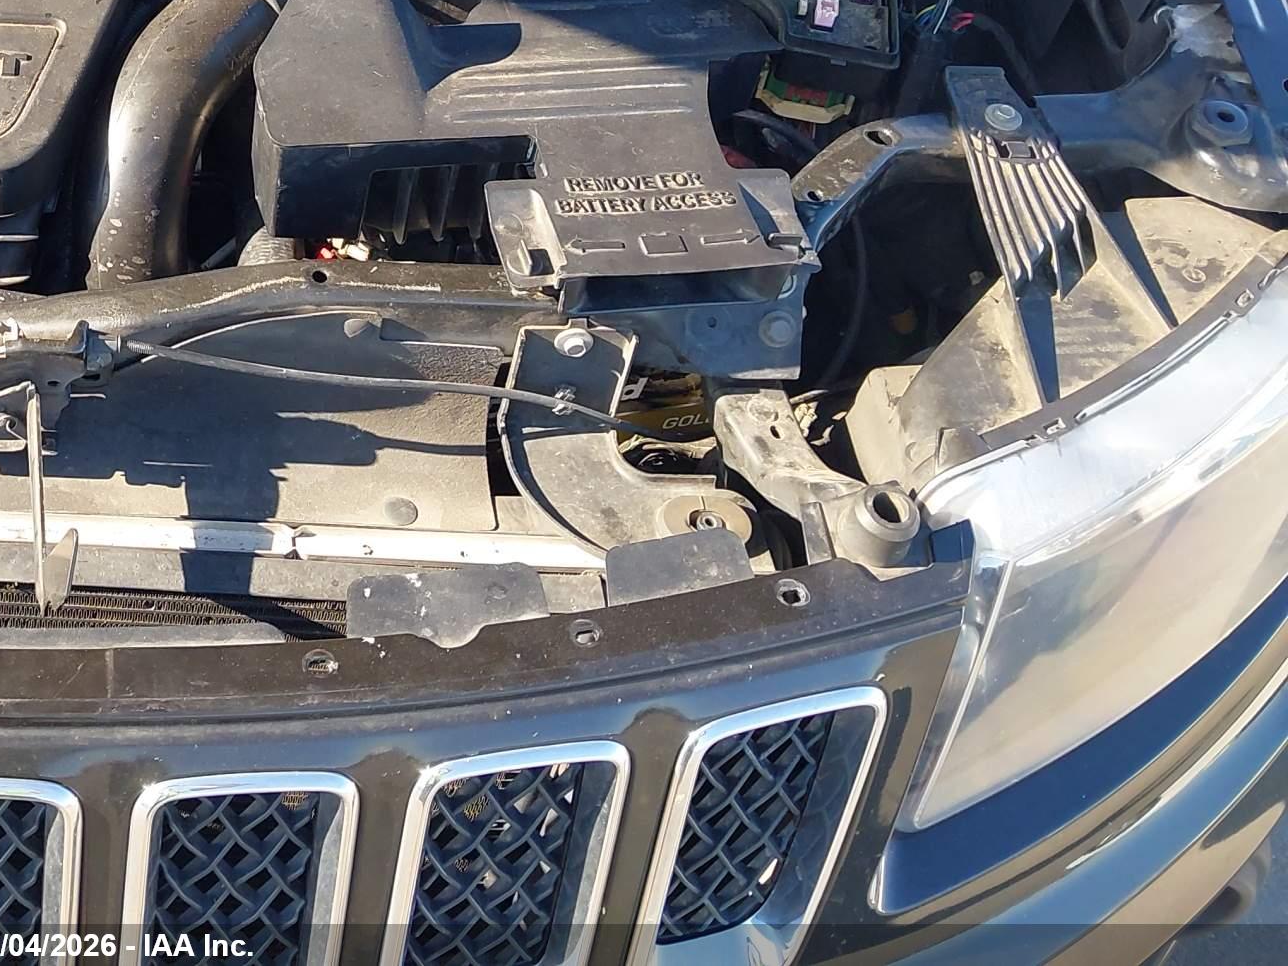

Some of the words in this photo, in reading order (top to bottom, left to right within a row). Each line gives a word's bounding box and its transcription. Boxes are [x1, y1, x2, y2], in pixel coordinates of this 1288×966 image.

[564, 175, 658, 193] REMOVE
[656, 170, 704, 190] FOR
[555, 196, 647, 215] BATTERY
[651, 191, 737, 212] ACCESS
[662, 414, 709, 429] GOL
